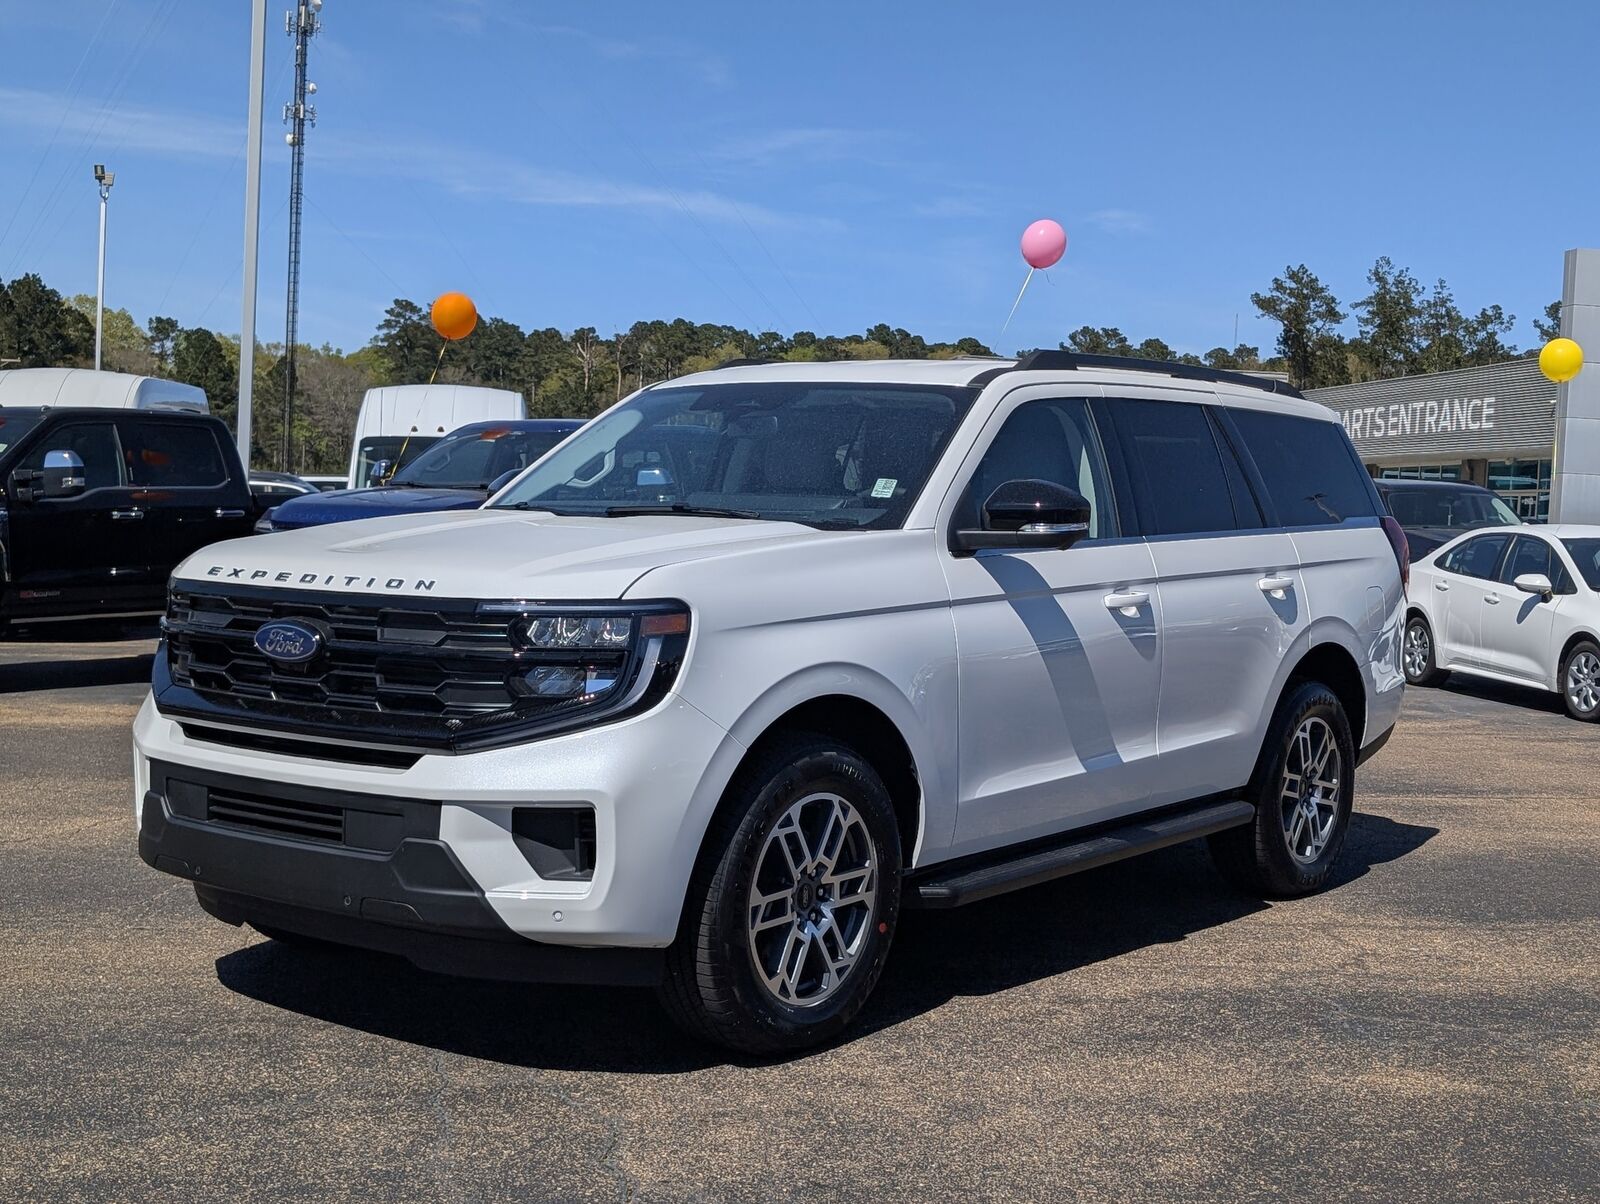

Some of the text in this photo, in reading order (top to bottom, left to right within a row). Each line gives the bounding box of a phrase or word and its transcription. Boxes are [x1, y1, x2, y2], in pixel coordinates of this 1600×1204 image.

[1342, 406, 1386, 439] ARTS
[207, 566, 437, 591] EXPEDITION
[265, 628, 304, 654] Ford
